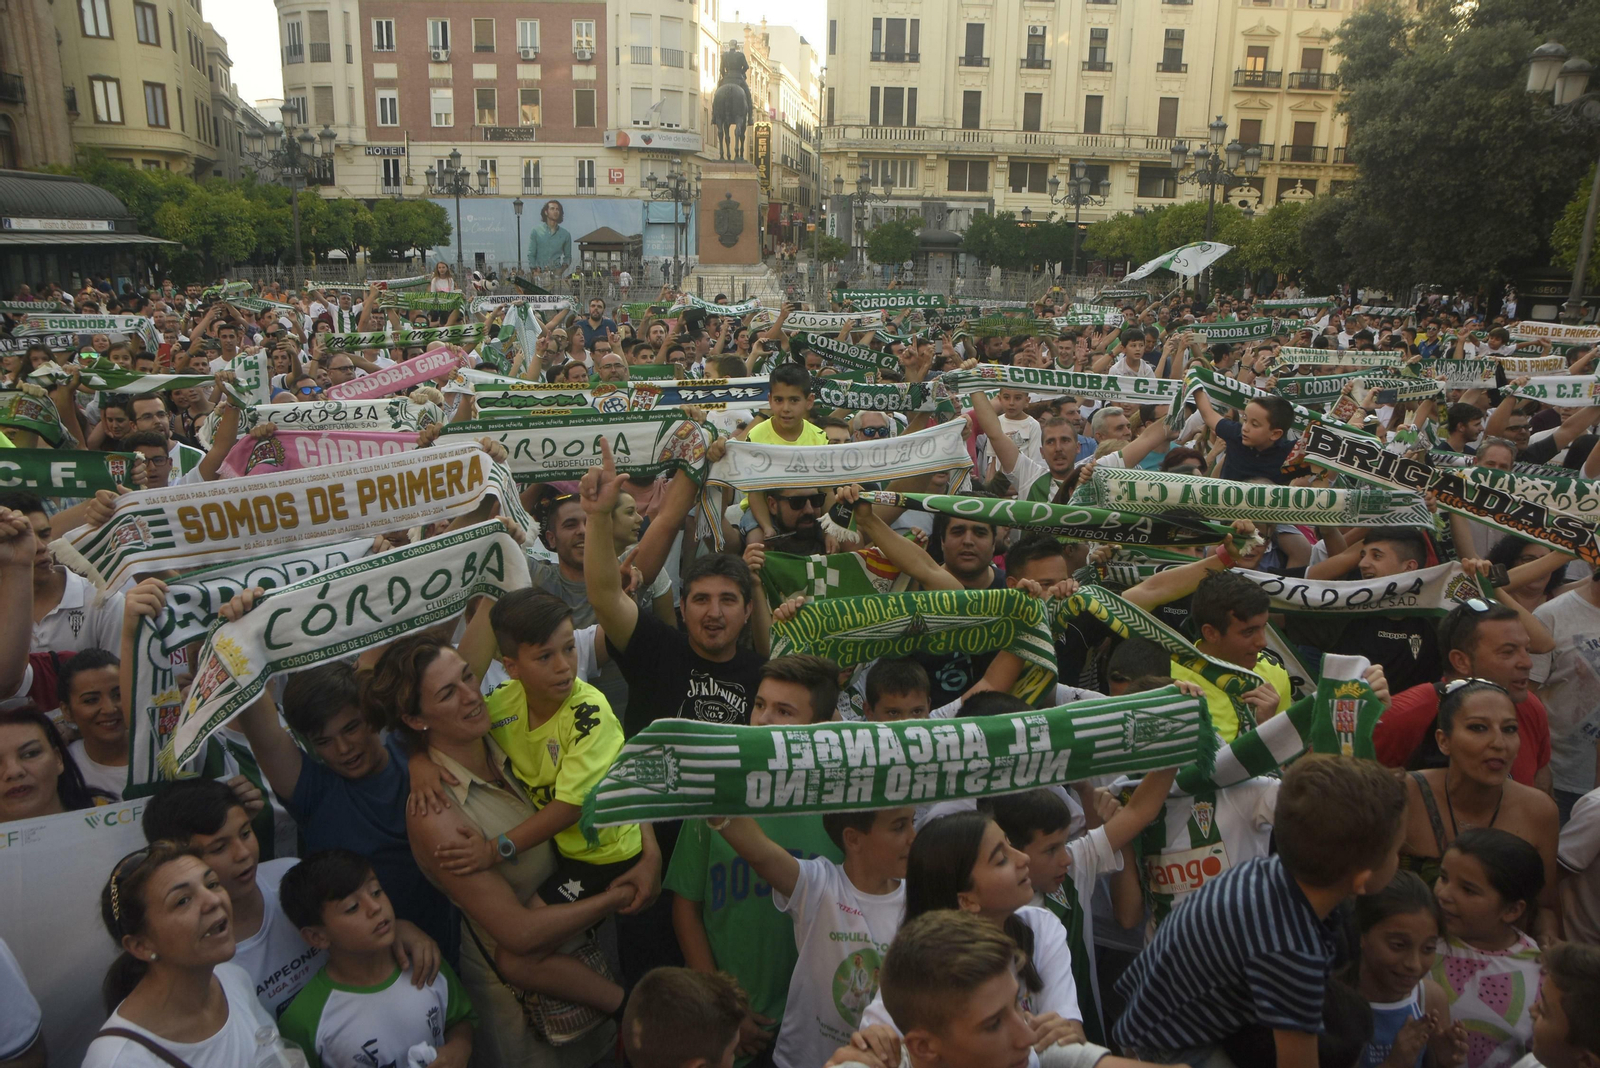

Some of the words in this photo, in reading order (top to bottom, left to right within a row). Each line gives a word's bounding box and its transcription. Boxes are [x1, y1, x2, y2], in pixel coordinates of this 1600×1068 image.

[365, 147, 405, 155] HOTEL
[1531, 286, 1563, 294] ASEOS
[1519, 325, 1549, 336] SOMOS
[1551, 327, 1562, 336] DE
[267, 405, 379, 424] CÓRDOBA
[50, 461, 87, 488] F.
[1306, 424, 1597, 547] BRIGADAS
[177, 492, 300, 545] SOMOS
[305, 482, 349, 526] DE
[356, 454, 484, 517] PRIMERA
[401, 540, 443, 558] CÓRDOBA
[443, 535, 463, 547] CLUB
[463, 532, 475, 541] DE
[1113, 532, 1150, 544] S.A.D.
[264, 541, 504, 650] CÓRDOBA
[280, 649, 326, 669] CÓRDOBA
[326, 643, 349, 657] CLUB
[349, 638, 359, 648] DE
[414, 606, 450, 627] CÓRDOBA
[1377, 630, 1408, 639] Kappa
[103, 805, 143, 827] CCF
[267, 981, 289, 999] LIGA
[290, 965, 310, 983] 18/19
